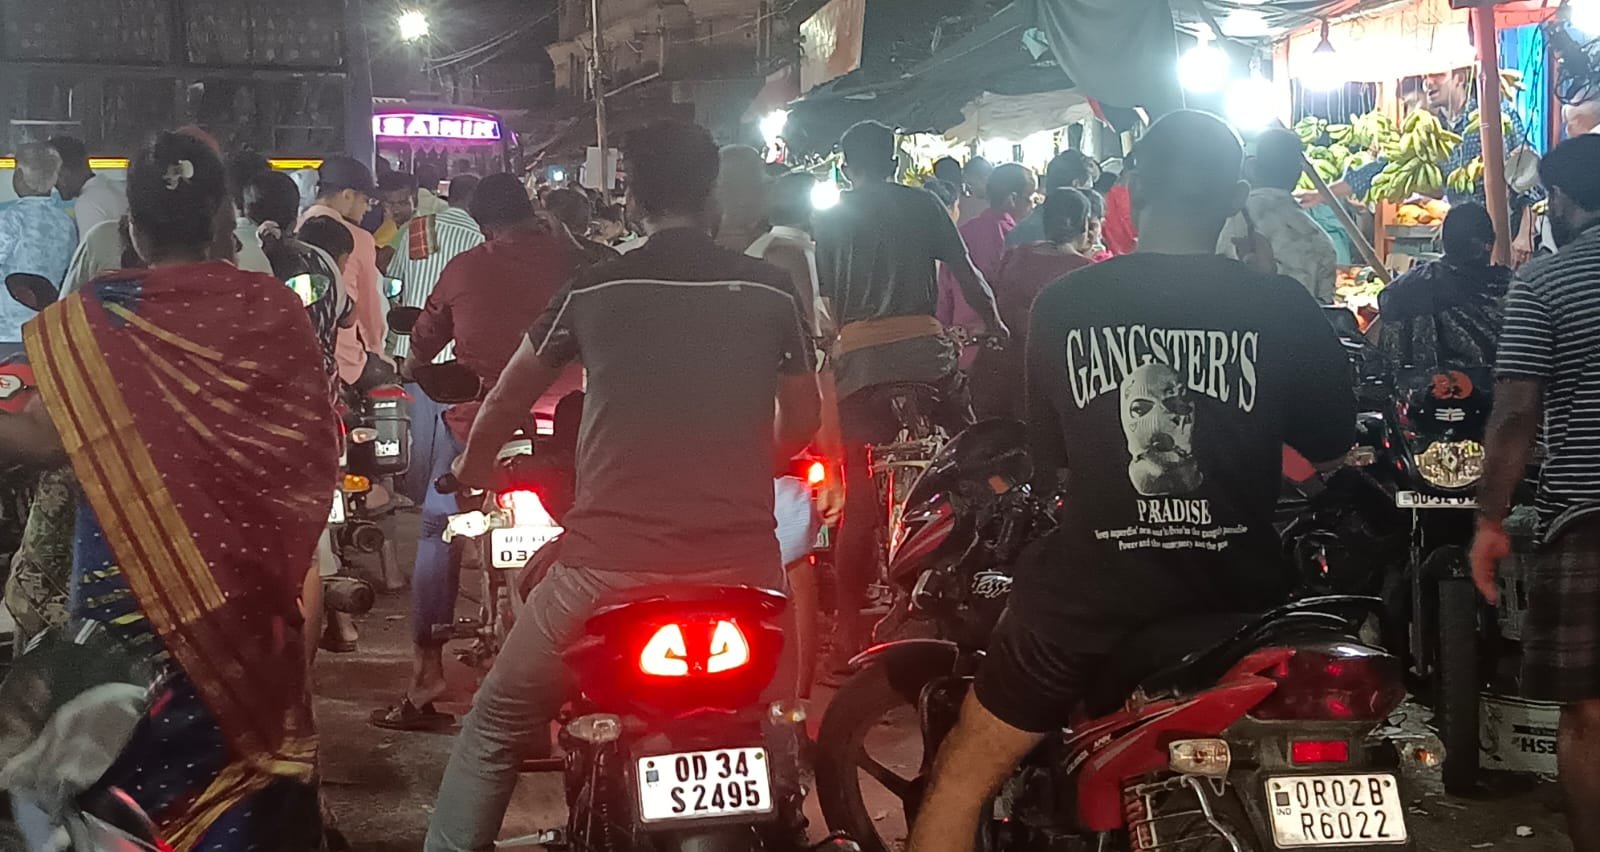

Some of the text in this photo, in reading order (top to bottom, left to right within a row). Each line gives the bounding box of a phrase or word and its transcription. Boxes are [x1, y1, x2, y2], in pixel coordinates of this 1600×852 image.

[1066, 323, 1259, 413] GANGSTER'S
[1136, 498, 1212, 525] PRADISE
[675, 751, 749, 782] OD 34
[1296, 777, 1383, 809] OR02B
[1301, 810, 1390, 841] R6022
